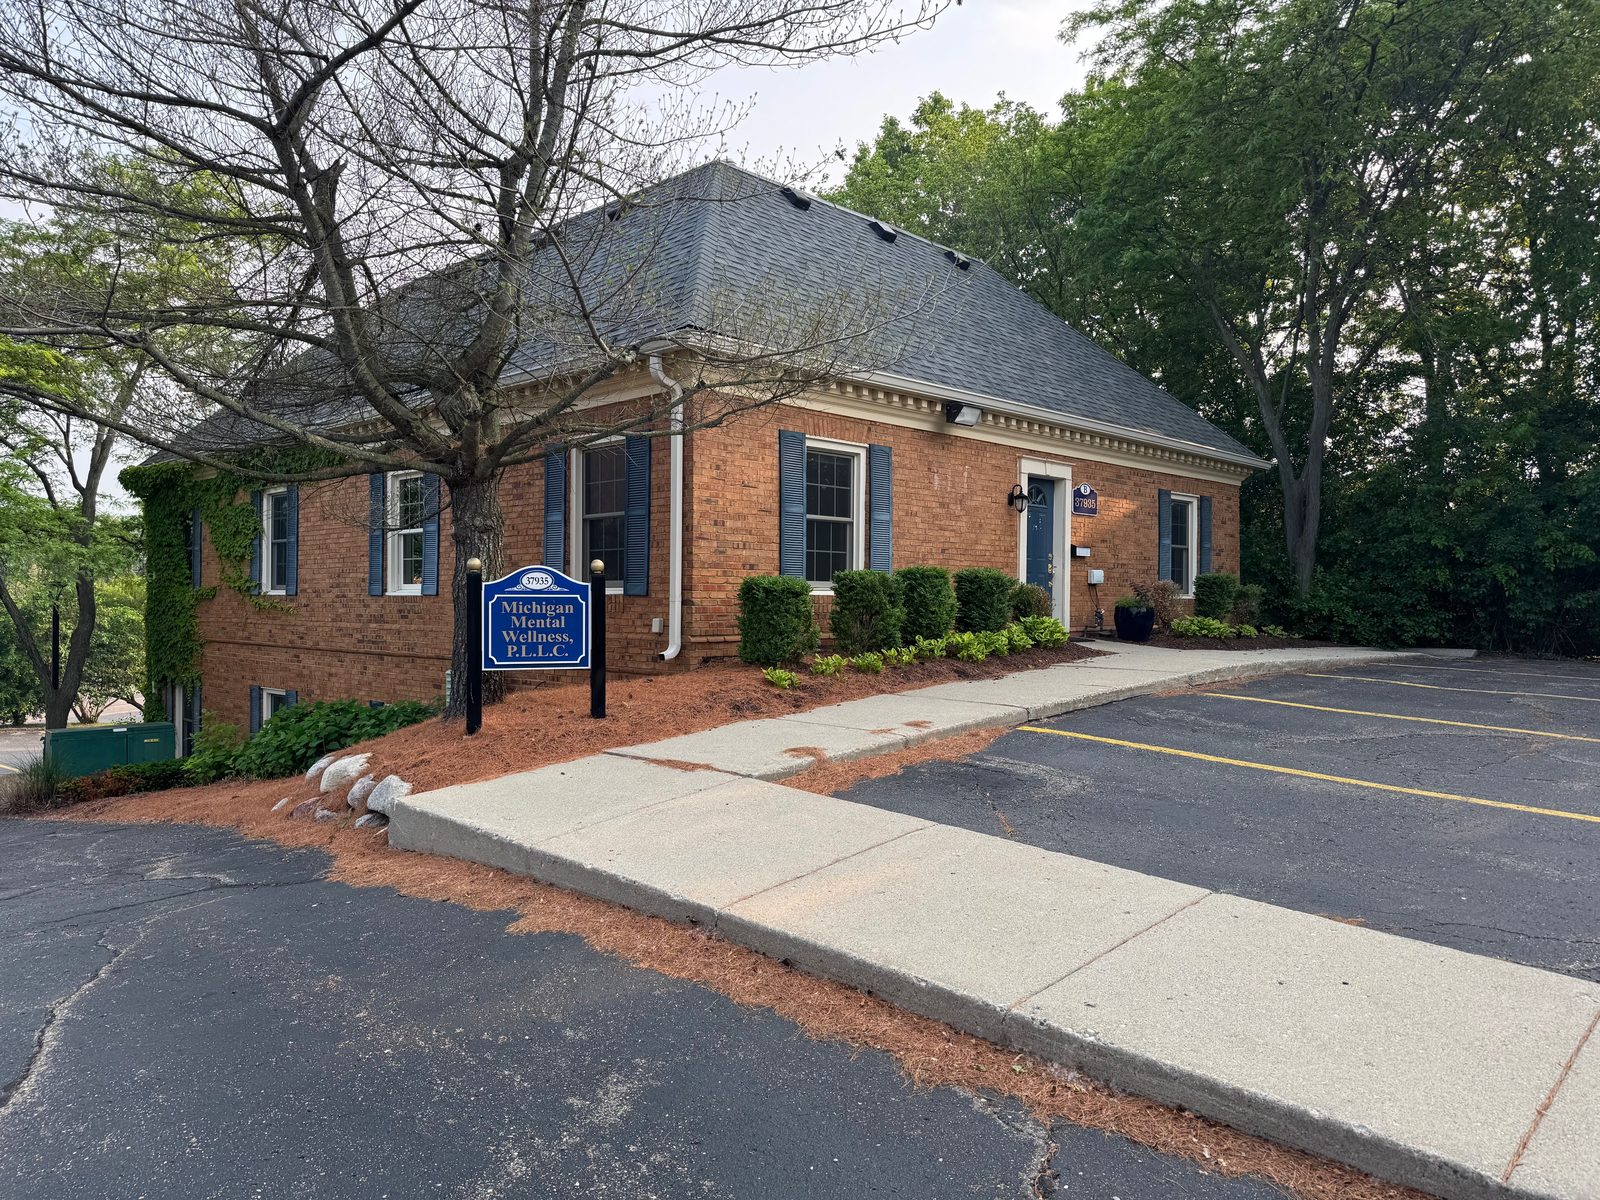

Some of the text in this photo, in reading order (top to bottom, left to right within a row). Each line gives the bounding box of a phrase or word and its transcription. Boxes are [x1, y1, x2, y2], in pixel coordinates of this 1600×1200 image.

[1074, 497, 1096, 509] 37935
[525, 576, 549, 585] 37935
[501, 601, 574, 616] Michigan
[511, 616, 565, 628] Mental
[502, 630, 574, 644] Wellness,
[506, 644, 569, 658] P.L.L.C.
